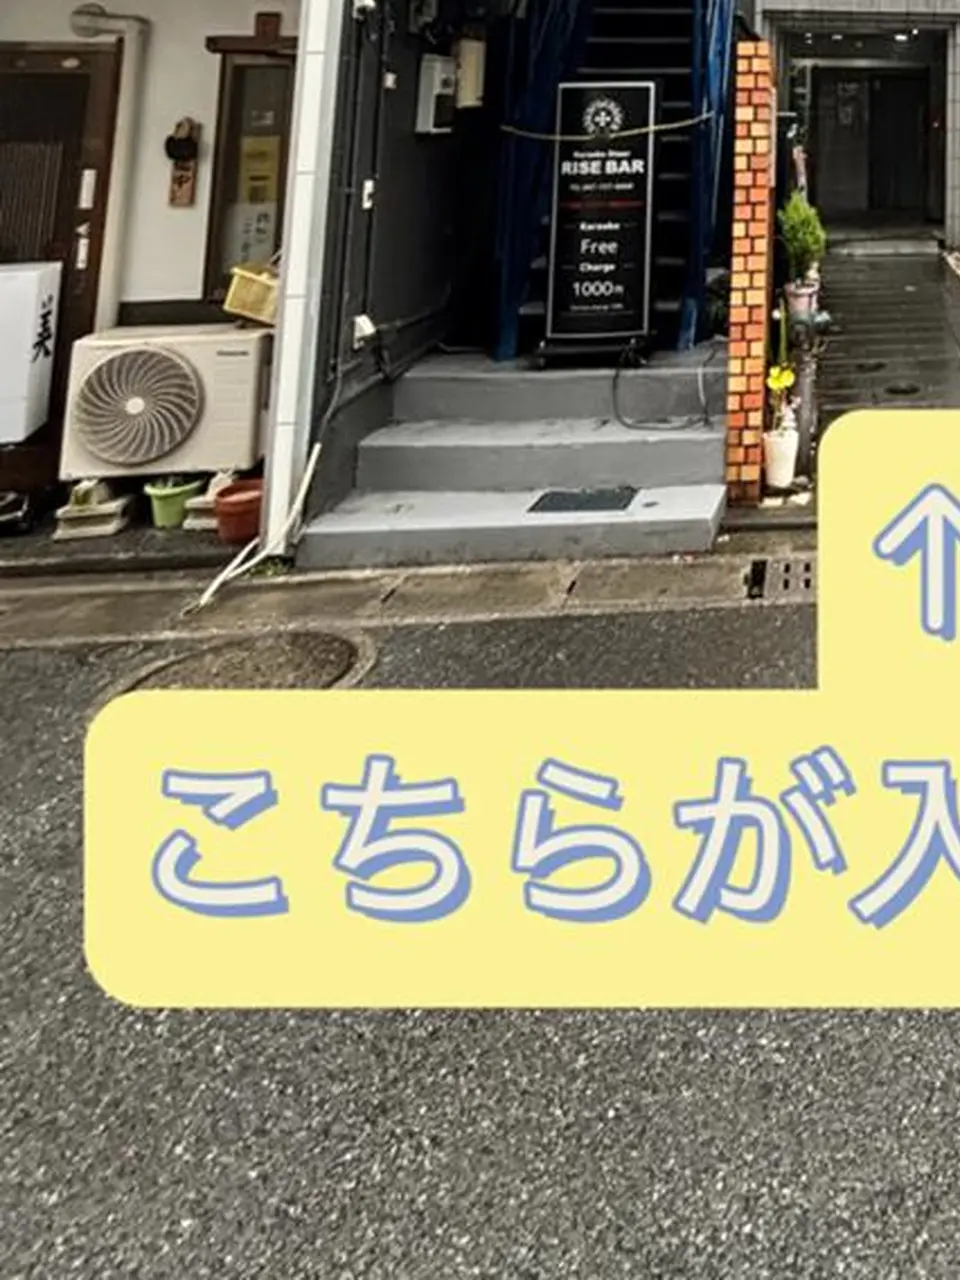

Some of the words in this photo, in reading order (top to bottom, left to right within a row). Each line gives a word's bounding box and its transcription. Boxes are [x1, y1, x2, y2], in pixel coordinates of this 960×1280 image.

[561, 160, 602, 175] RISE
[605, 159, 645, 174] BAR
[580, 238, 618, 254] Free
[579, 262, 616, 273] Charge
